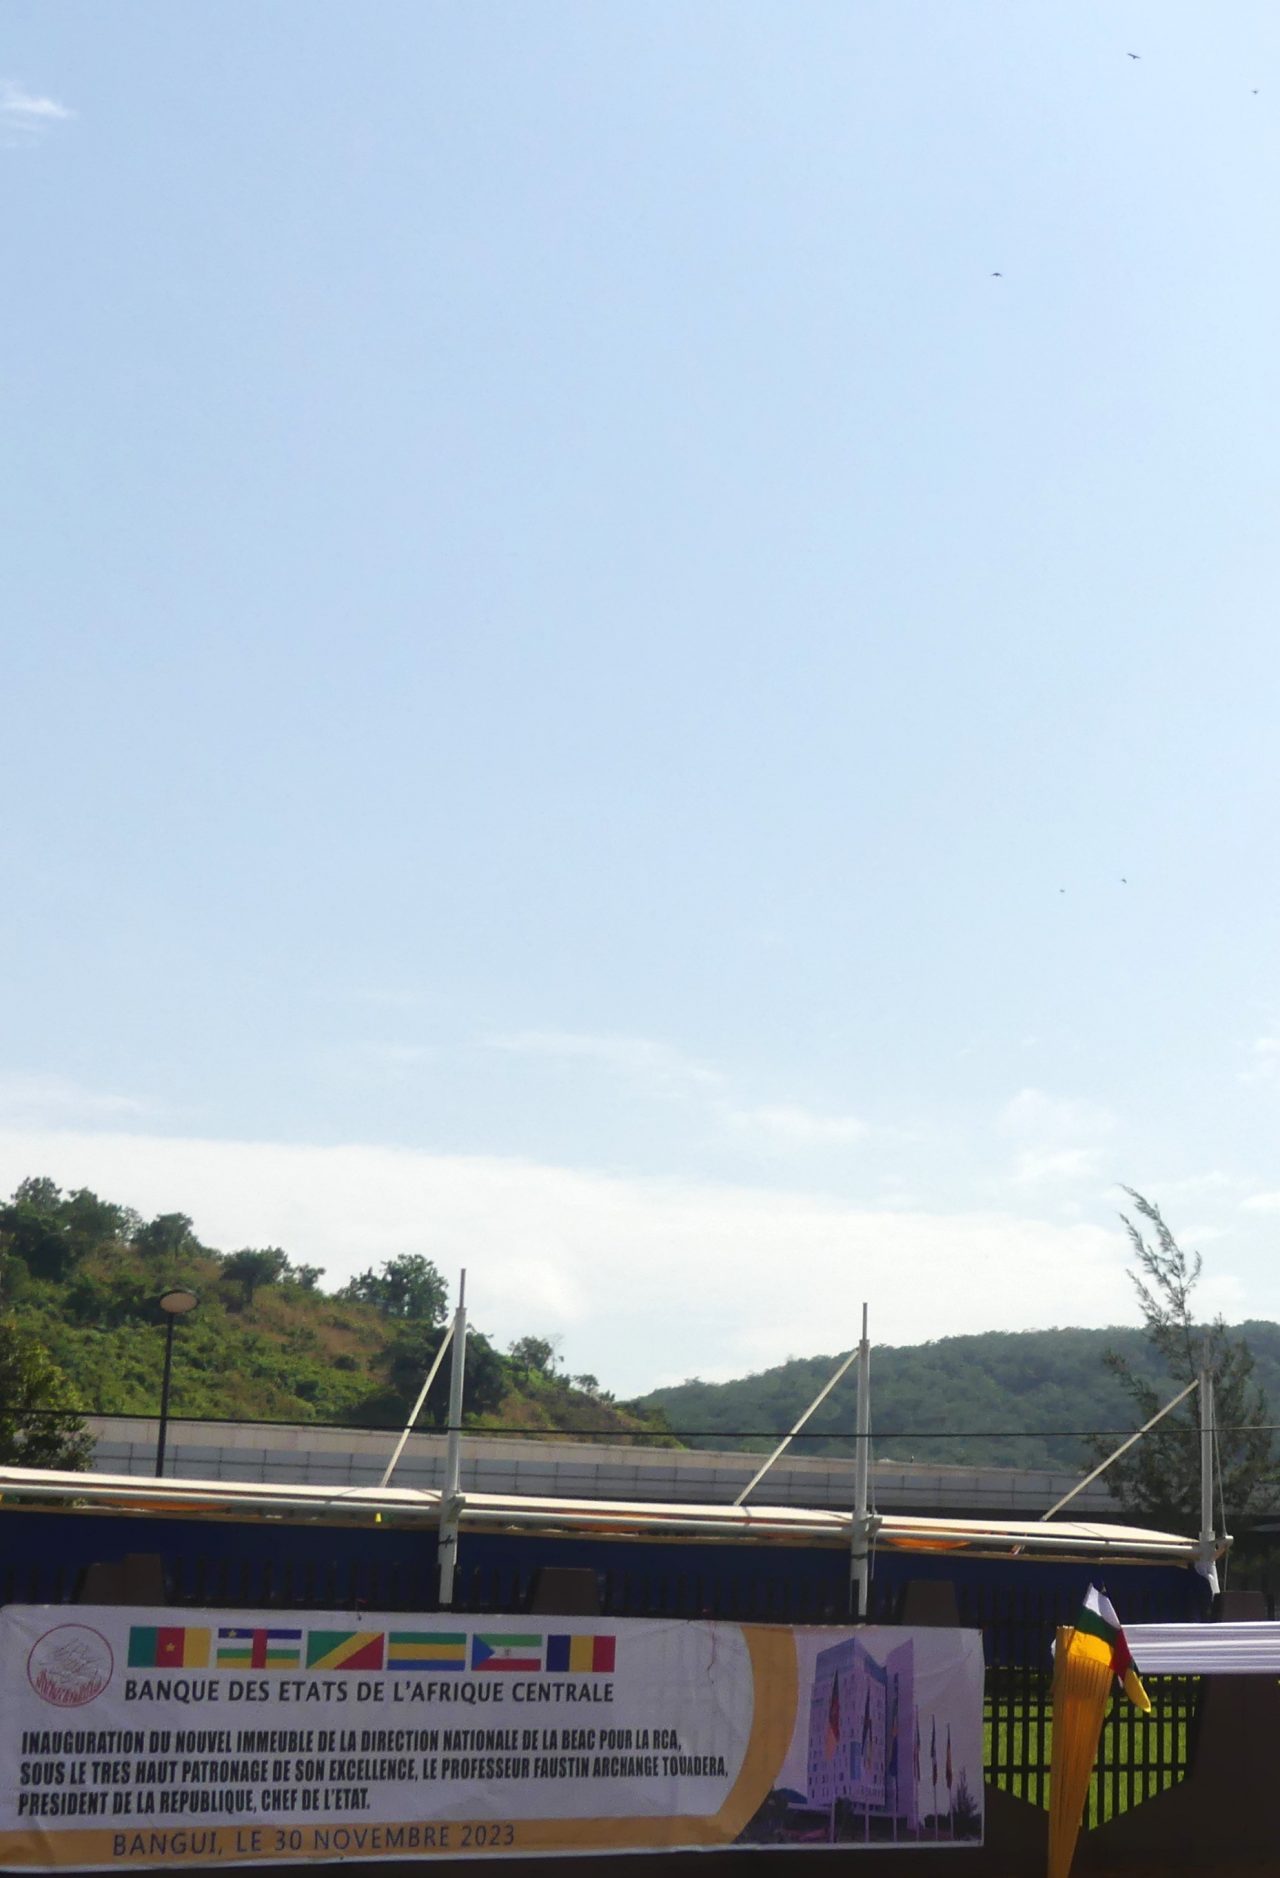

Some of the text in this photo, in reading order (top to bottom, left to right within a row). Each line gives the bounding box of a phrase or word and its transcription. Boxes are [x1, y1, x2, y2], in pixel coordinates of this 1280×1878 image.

[125, 1680, 219, 1704] BANQUE
[228, 1680, 270, 1701] DES
[279, 1681, 348, 1702] ETATS
[357, 1682, 384, 1701] DE
[512, 1682, 614, 1702] CENTRALE
[21, 1729, 682, 1755] INAUGURATION DU NOUVEL IMMEUBLE DE LA DIRECTION NATIONALE DE LA BEAC POUR LA RCA,
[20, 1756, 728, 1786] SOUS LE TRES HAUT PATRONAGE DE SON EXCELLENCE, LE PROFESSEUR FAUSTIN ARCHANGE TOUADERA,
[17, 1792, 109, 1817] PRESIDENT
[112, 1792, 132, 1815] DE
[136, 1791, 155, 1814] LA
[159, 1789, 257, 1815] REPUBLIQUE,
[261, 1789, 299, 1812] CHEF
[301, 1788, 320, 1811] DE
[113, 1824, 515, 1857] BANGUI, LE 30 NOVEMBRE 2023
